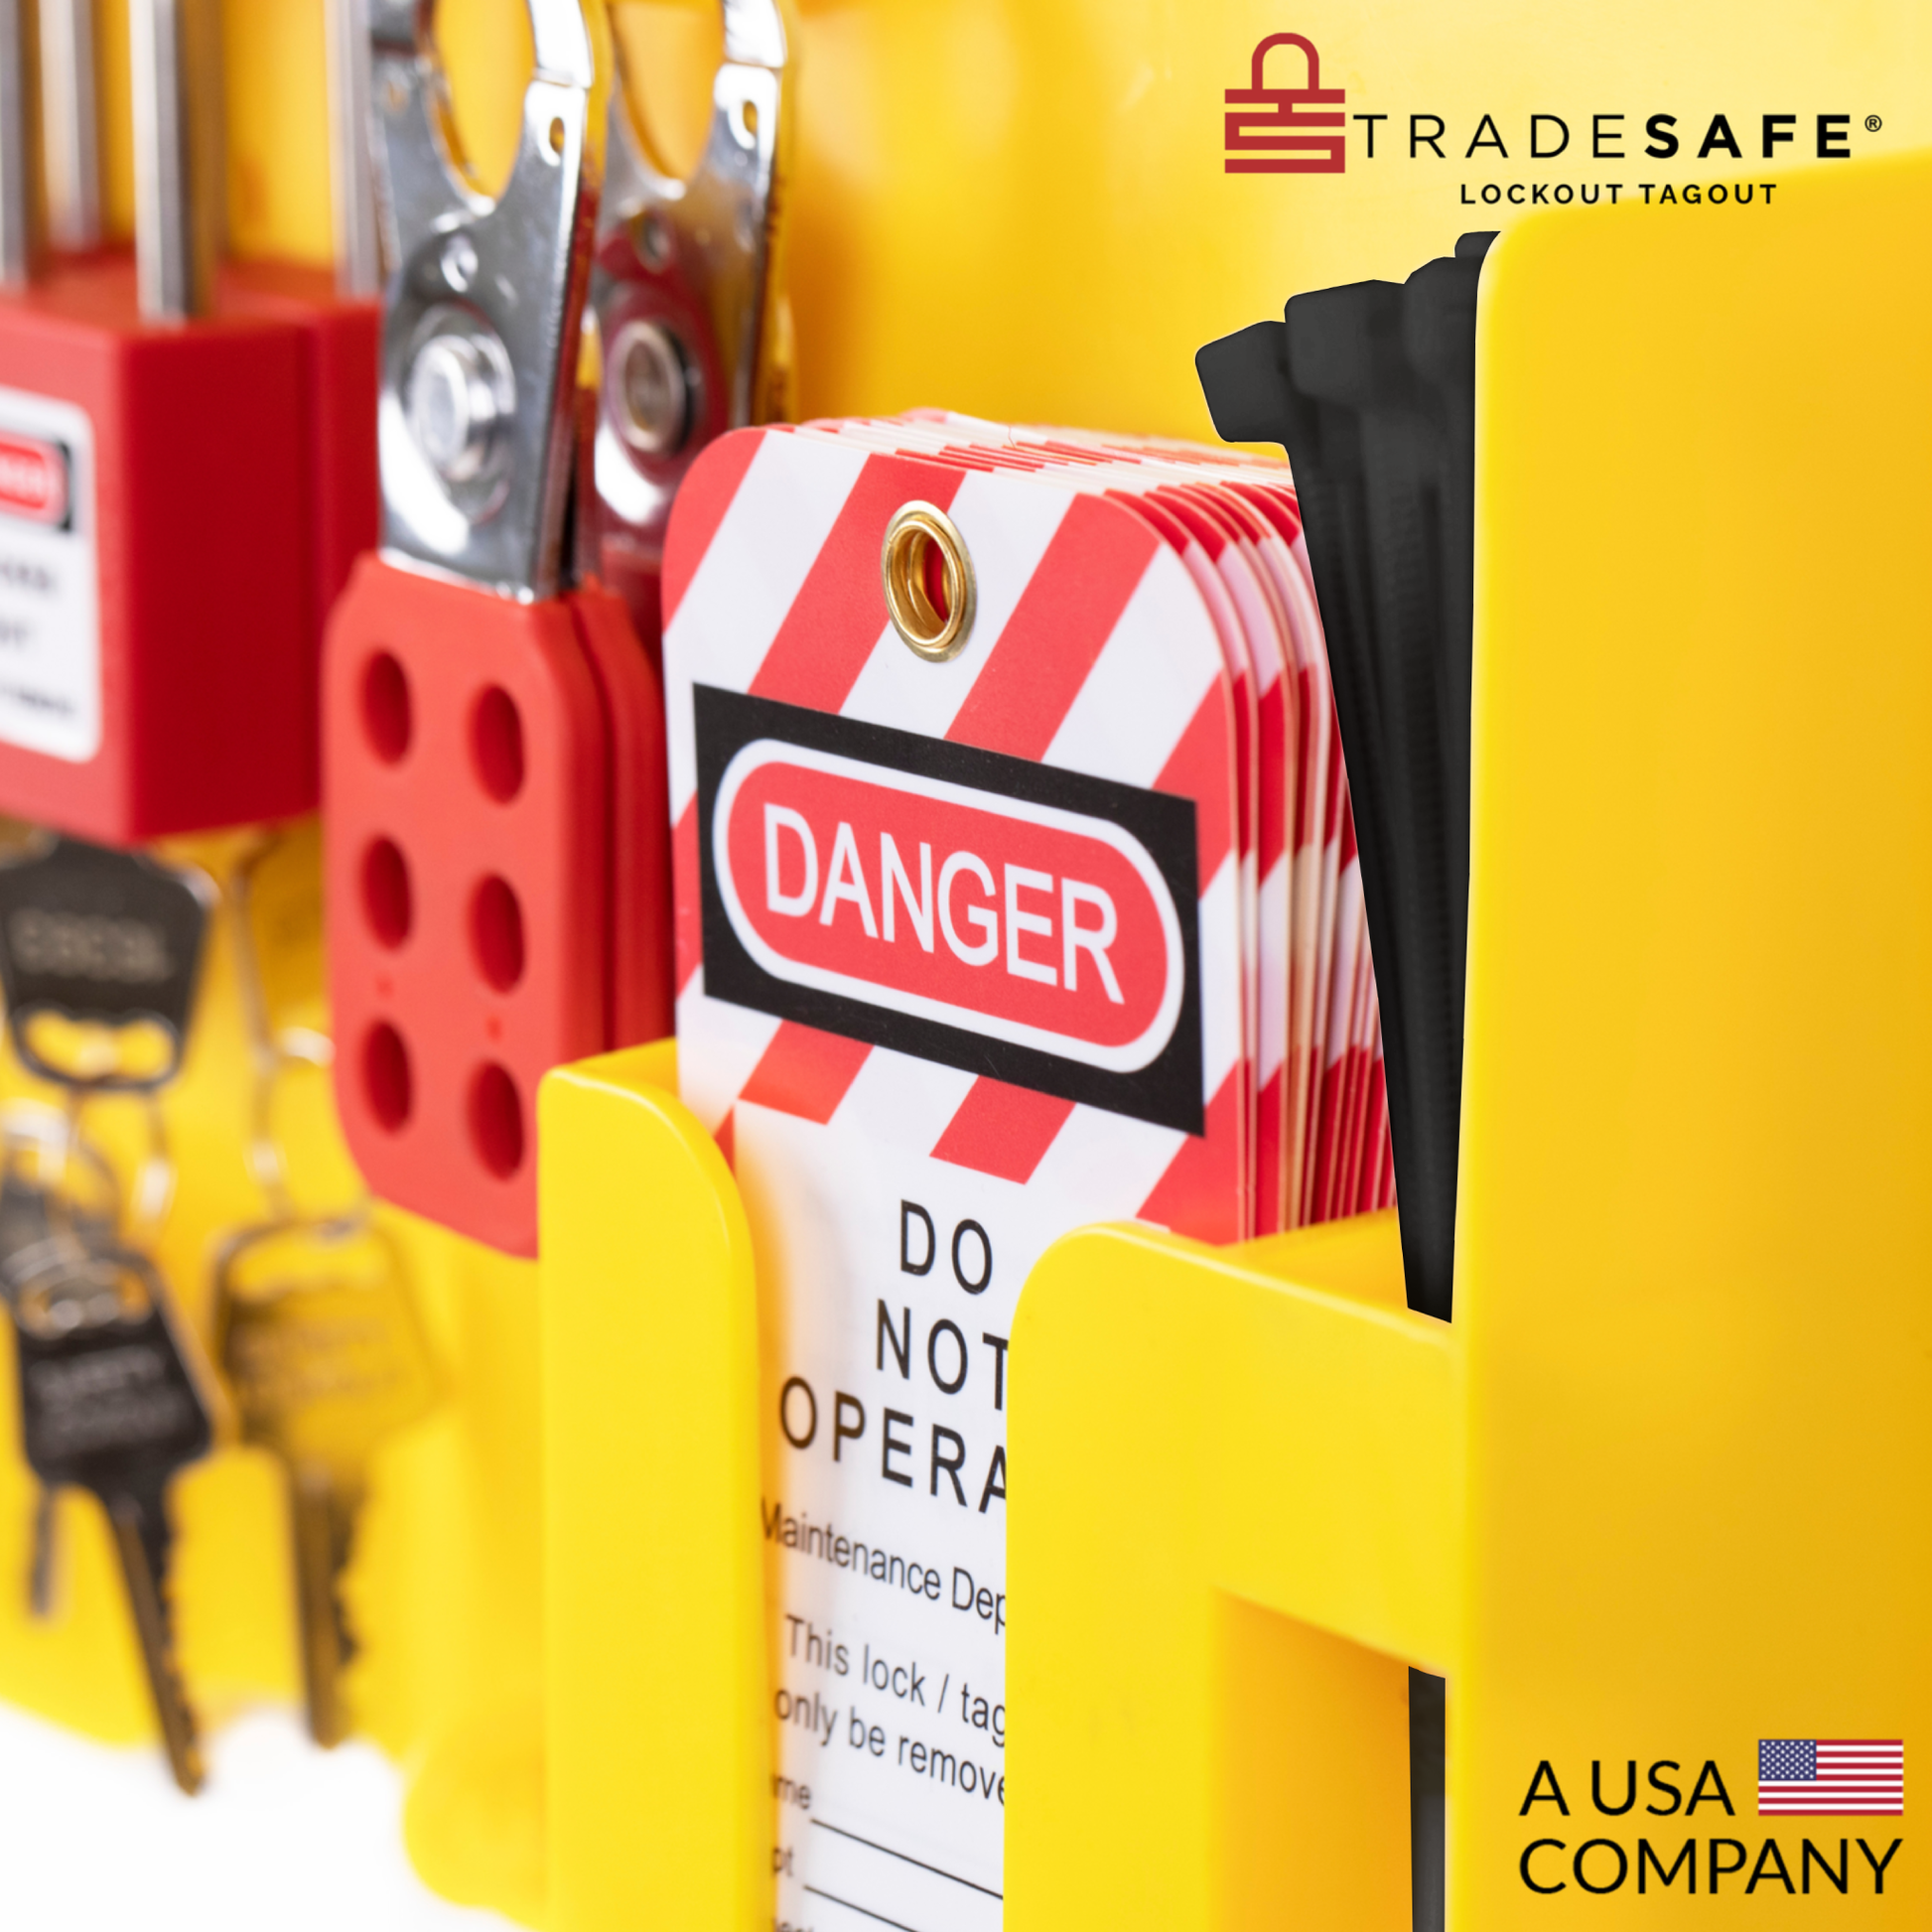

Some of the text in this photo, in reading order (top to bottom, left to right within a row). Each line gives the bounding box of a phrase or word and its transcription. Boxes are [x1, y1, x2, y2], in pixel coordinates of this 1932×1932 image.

[763, 802, 1125, 1005] DANGER
[900, 1198, 993, 1296] DO
[876, 1298, 1009, 1412] NOT
[779, 1376, 1007, 1514] OPERA
[760, 1496, 1006, 1635] Maintenance Dep
[773, 1689, 837, 1747] only
[848, 1706, 886, 1757] be
[785, 1613, 1006, 1748] This lock / tag
